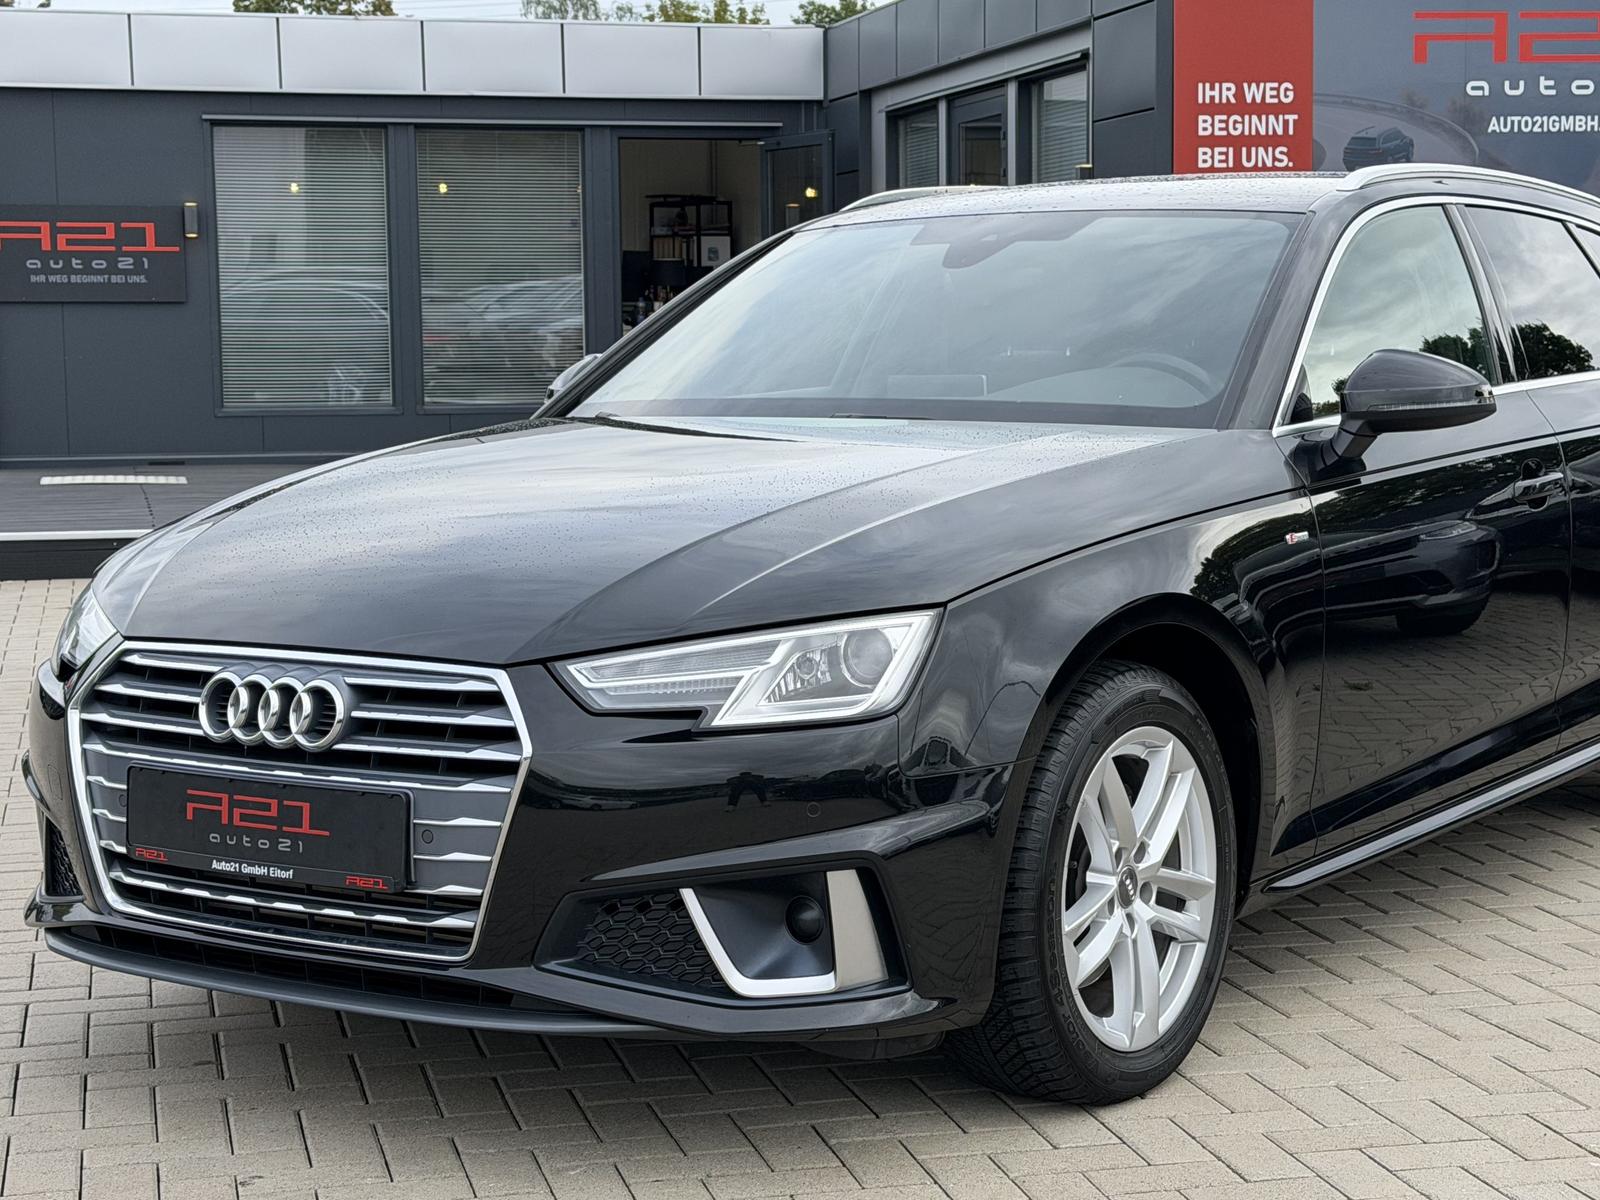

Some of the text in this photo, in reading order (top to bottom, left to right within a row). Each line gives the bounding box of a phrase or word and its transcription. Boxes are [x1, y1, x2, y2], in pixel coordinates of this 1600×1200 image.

[1197, 82, 1294, 104] IHR WEG
[1465, 75, 1595, 96] auto
[1197, 114, 1299, 136] BEGINNT
[1197, 146, 1294, 168] BEI UNS.
[0, 221, 180, 252] A21
[26, 256, 149, 269] auto21
[30, 274, 148, 284] IHR WEG BEGINNT BEI UNS.
[186, 788, 331, 837] A21
[209, 833, 303, 853] auto21
[135, 847, 169, 861] A21
[211, 859, 294, 880] Auto21 GmbH Eitorf
[345, 875, 389, 889] A21
